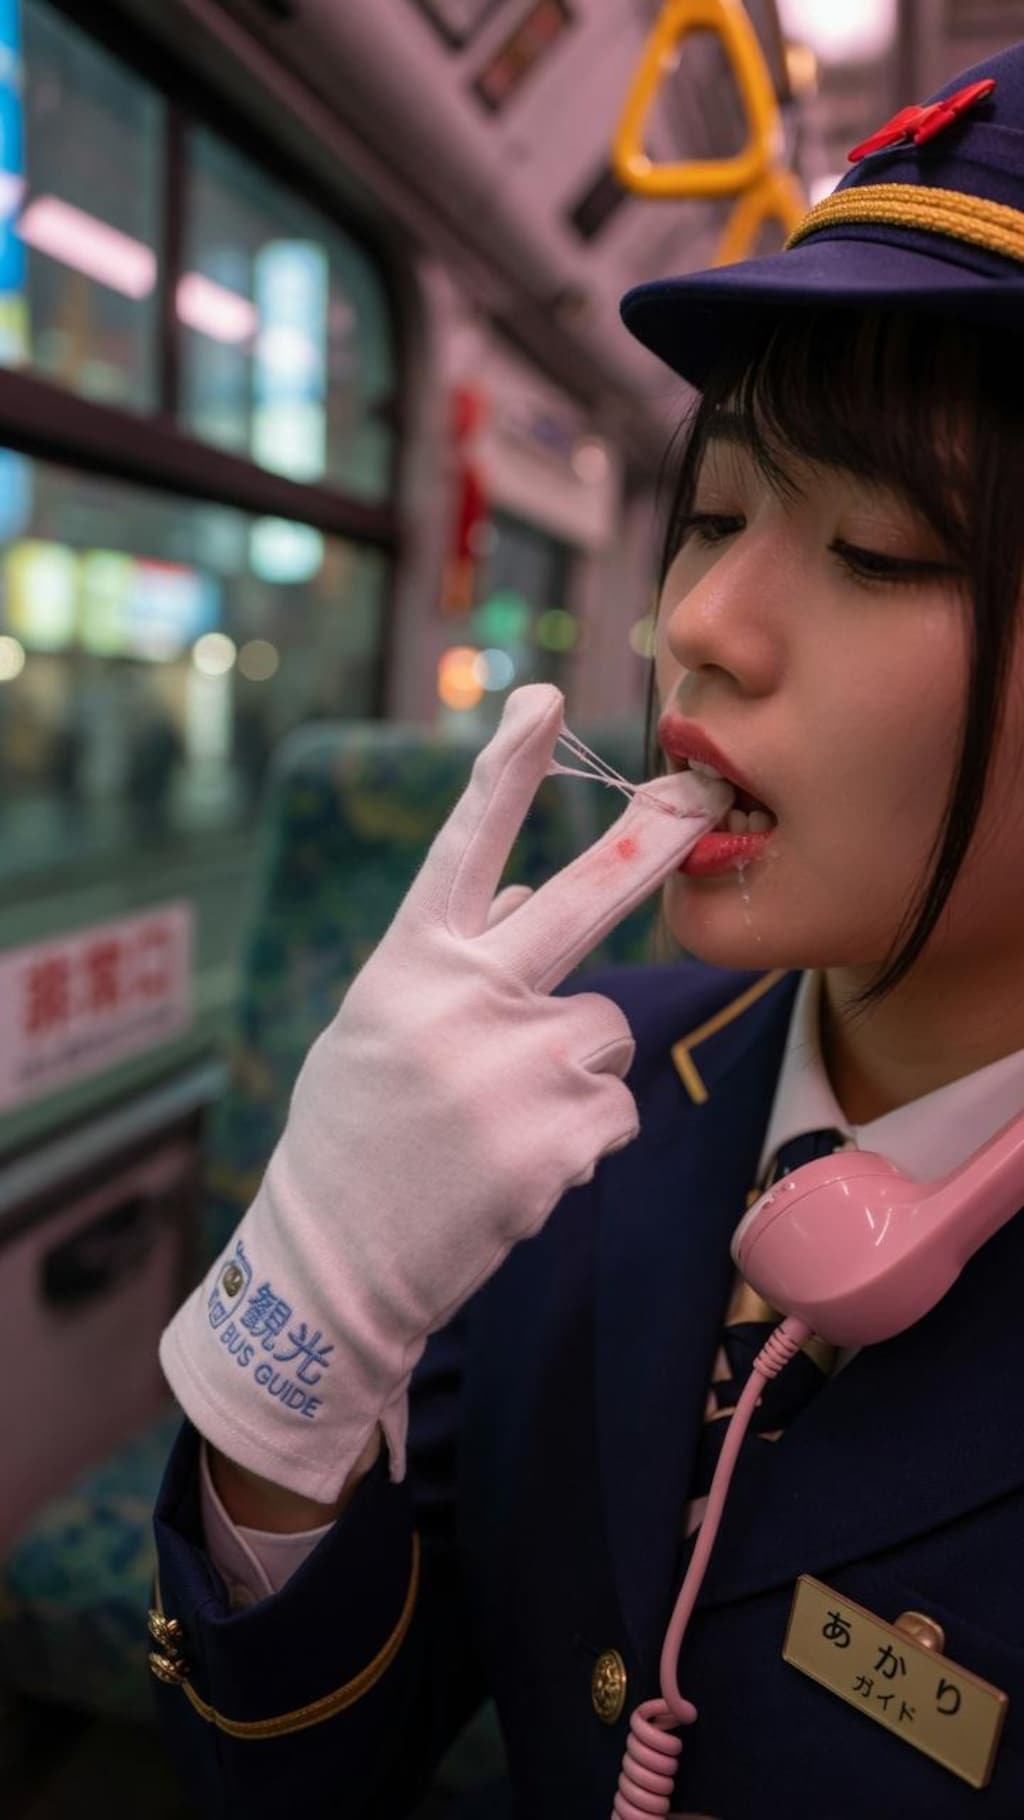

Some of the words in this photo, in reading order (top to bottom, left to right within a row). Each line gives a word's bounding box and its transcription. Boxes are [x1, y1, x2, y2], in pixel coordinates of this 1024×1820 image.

[220, 1322, 254, 1367] BUS
[254, 1364, 323, 1418] GUIDE
[241, 1283, 335, 1385] 観光
[822, 1611, 961, 1716] あかり
[852, 1675, 916, 1722] ガイド
